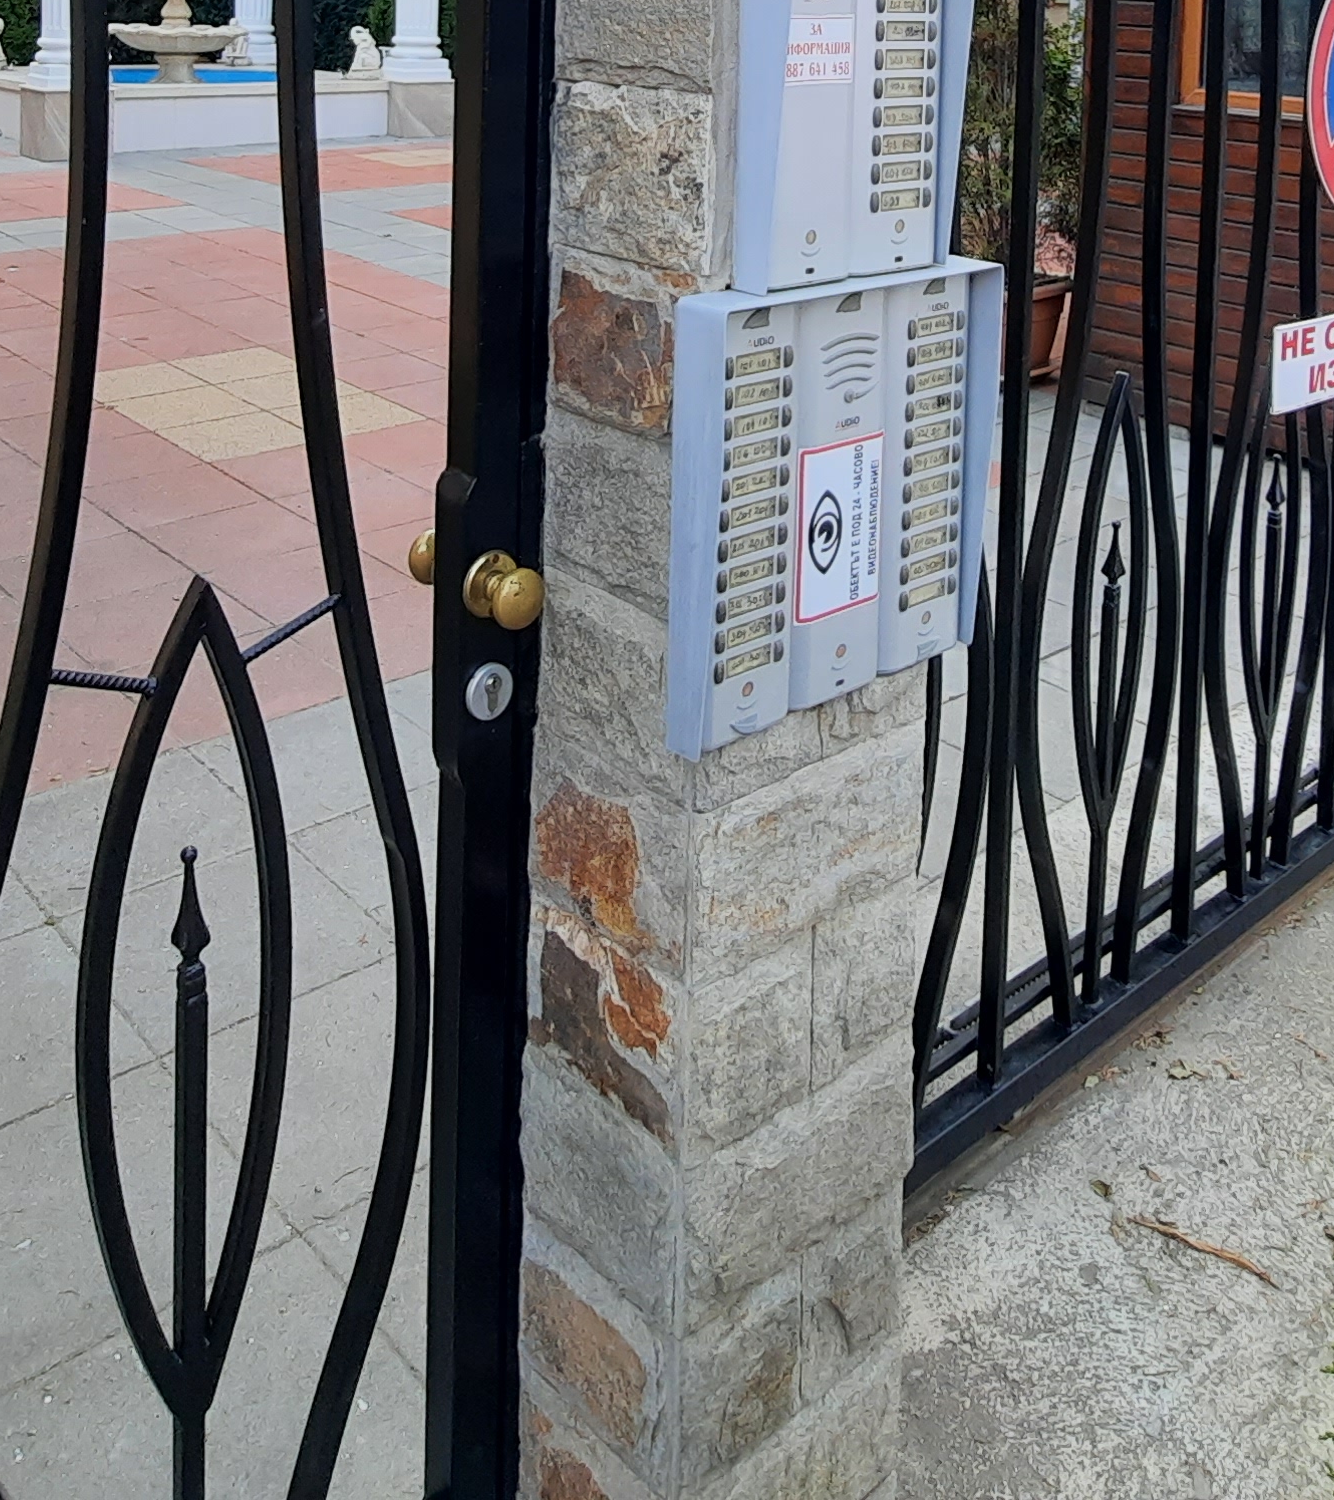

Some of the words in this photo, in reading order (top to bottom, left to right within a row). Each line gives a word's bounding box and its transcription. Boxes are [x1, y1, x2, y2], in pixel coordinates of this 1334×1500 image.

[809, 22, 823, 36] ЗА
[785, 41, 851, 56] НФОРМАЦИЯ
[1280, 325, 1316, 362] НЕ
[853, 443, 864, 491] ЧАСОВО
[852, 496, 862, 511] 24
[851, 512, 862, 538] ПОД
[852, 538, 860, 547] Е
[849, 549, 861, 601] ОБЕКТЪТ
